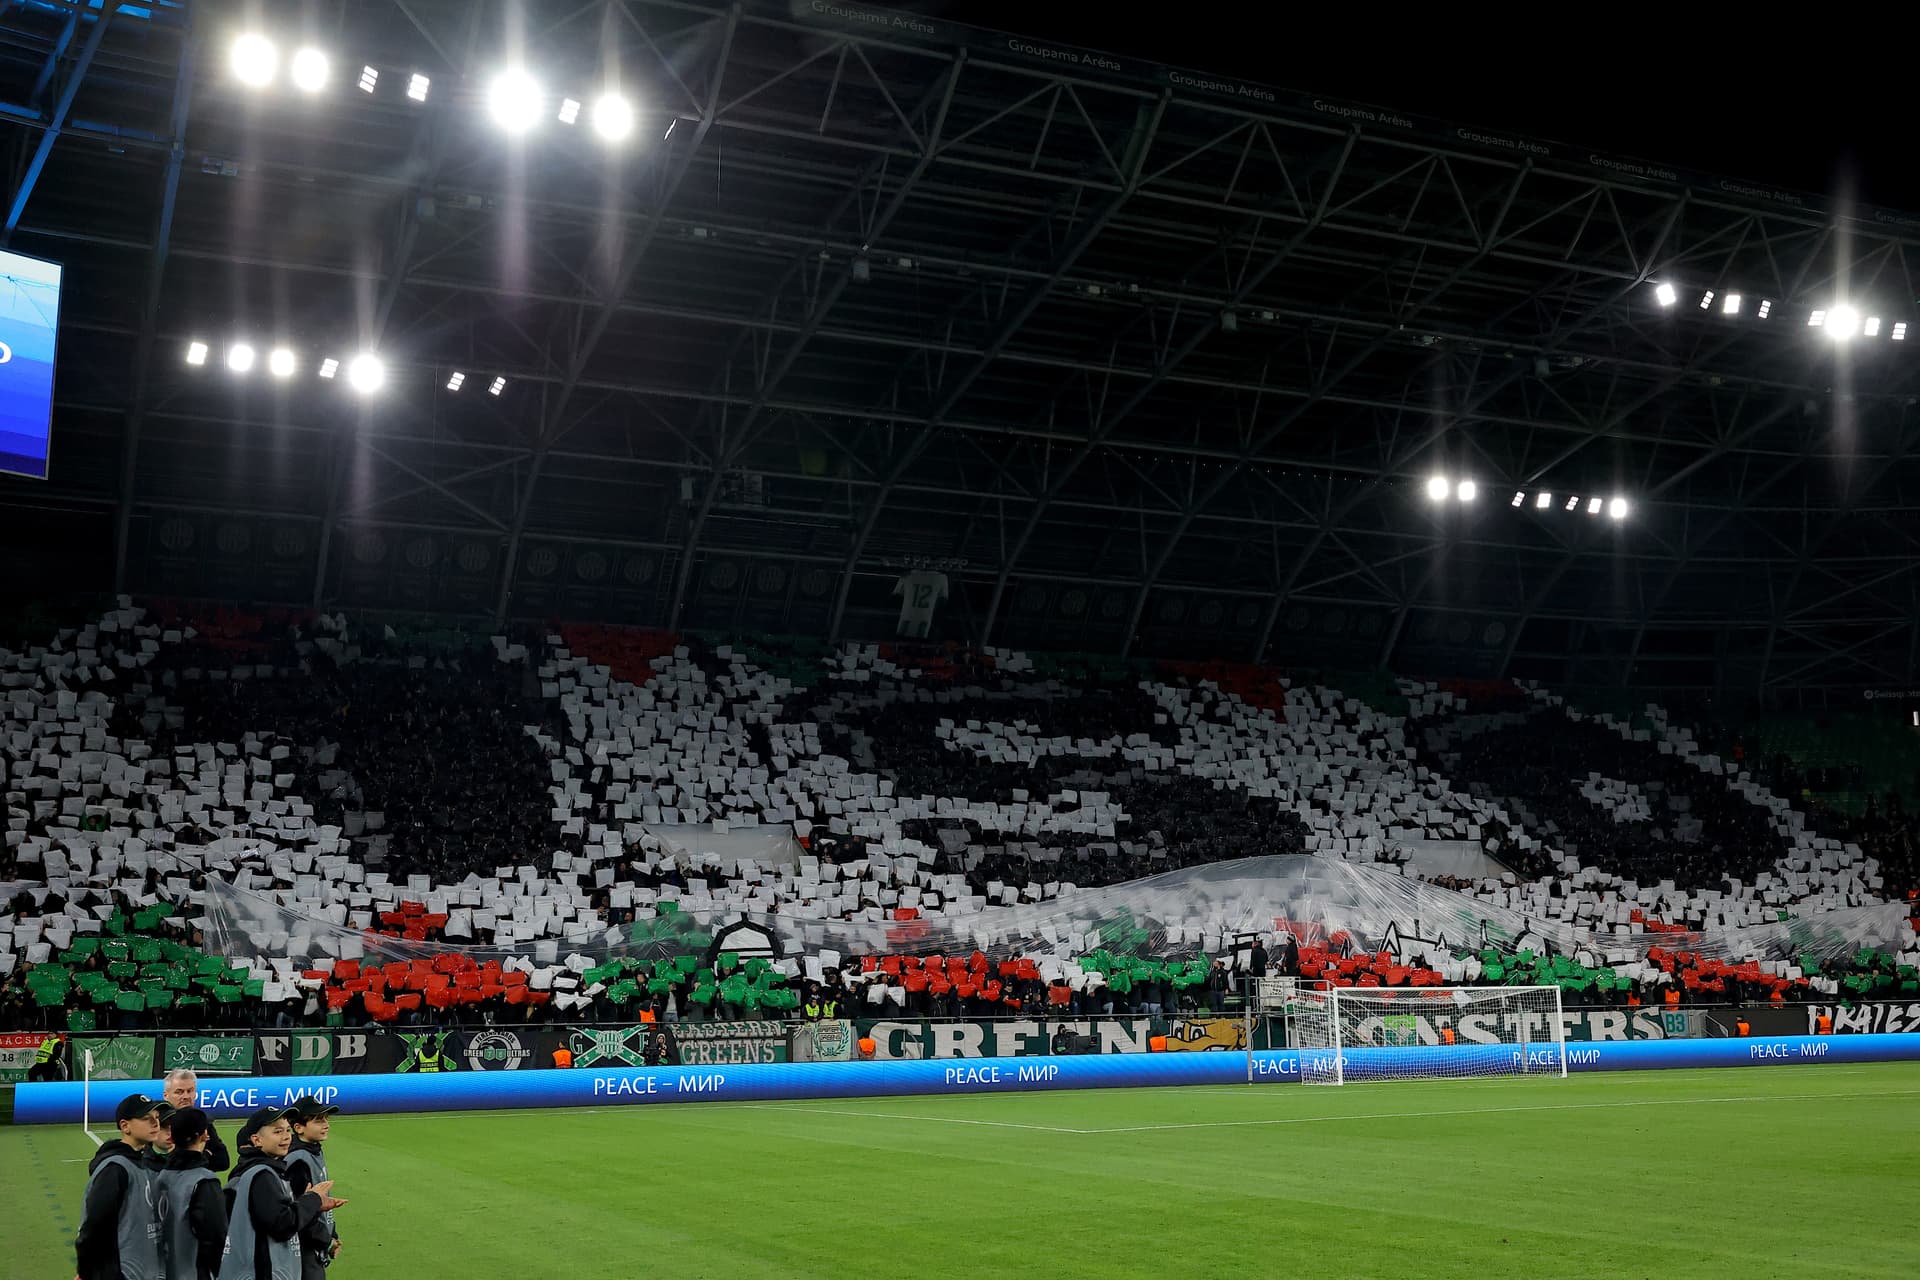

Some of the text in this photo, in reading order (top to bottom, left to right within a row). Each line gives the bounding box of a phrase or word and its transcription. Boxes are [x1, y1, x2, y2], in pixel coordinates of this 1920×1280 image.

[812, 0, 888, 25] Groupama
[1008, 39, 1121, 71] Groupama Aréna
[1169, 72, 1275, 101] Groupama Aréna
[1313, 100, 1376, 121] Groupama
[1457, 128, 1515, 148] Groupama
[912, 584, 932, 608] 12
[680, 1039, 776, 1065] GREENS
[1513, 1049, 1601, 1065] PACE МИР
[1750, 1043, 1789, 1059] PEACE
[1800, 1043, 1829, 1057] МИР
[594, 1076, 658, 1096] PEACE
[678, 1074, 726, 1094] МИР
[945, 1066, 1001, 1085] PEACE
[1018, 1064, 1059, 1083] МИР
[194, 1088, 259, 1109] EACE
